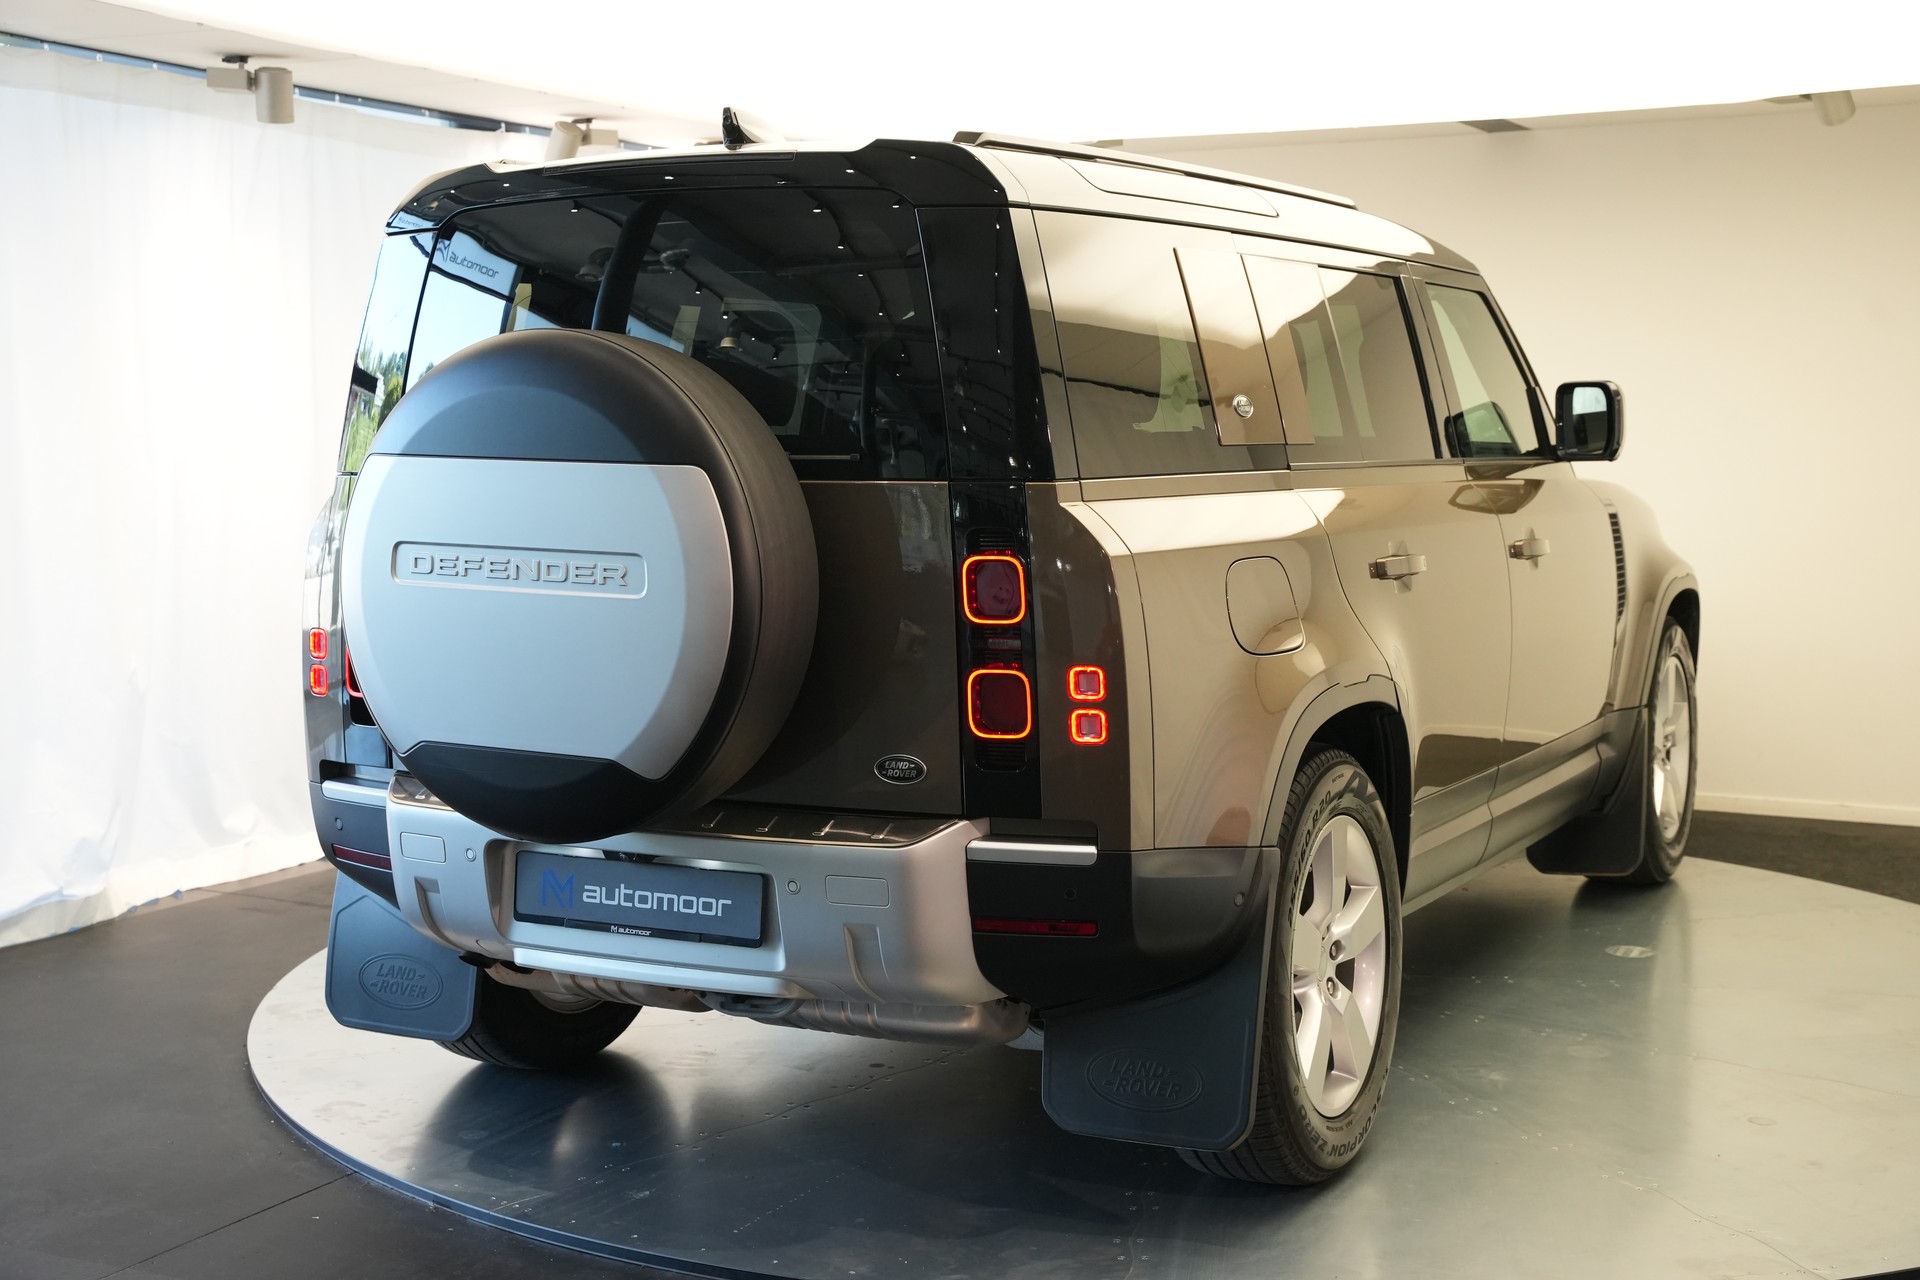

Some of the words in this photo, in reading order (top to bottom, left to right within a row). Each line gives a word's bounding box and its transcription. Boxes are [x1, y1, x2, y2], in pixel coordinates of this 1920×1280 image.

[449, 251, 499, 278] automoor
[410, 551, 628, 587] DEFENDER
[582, 883, 732, 917] automoor
[618, 927, 652, 936] automoor
